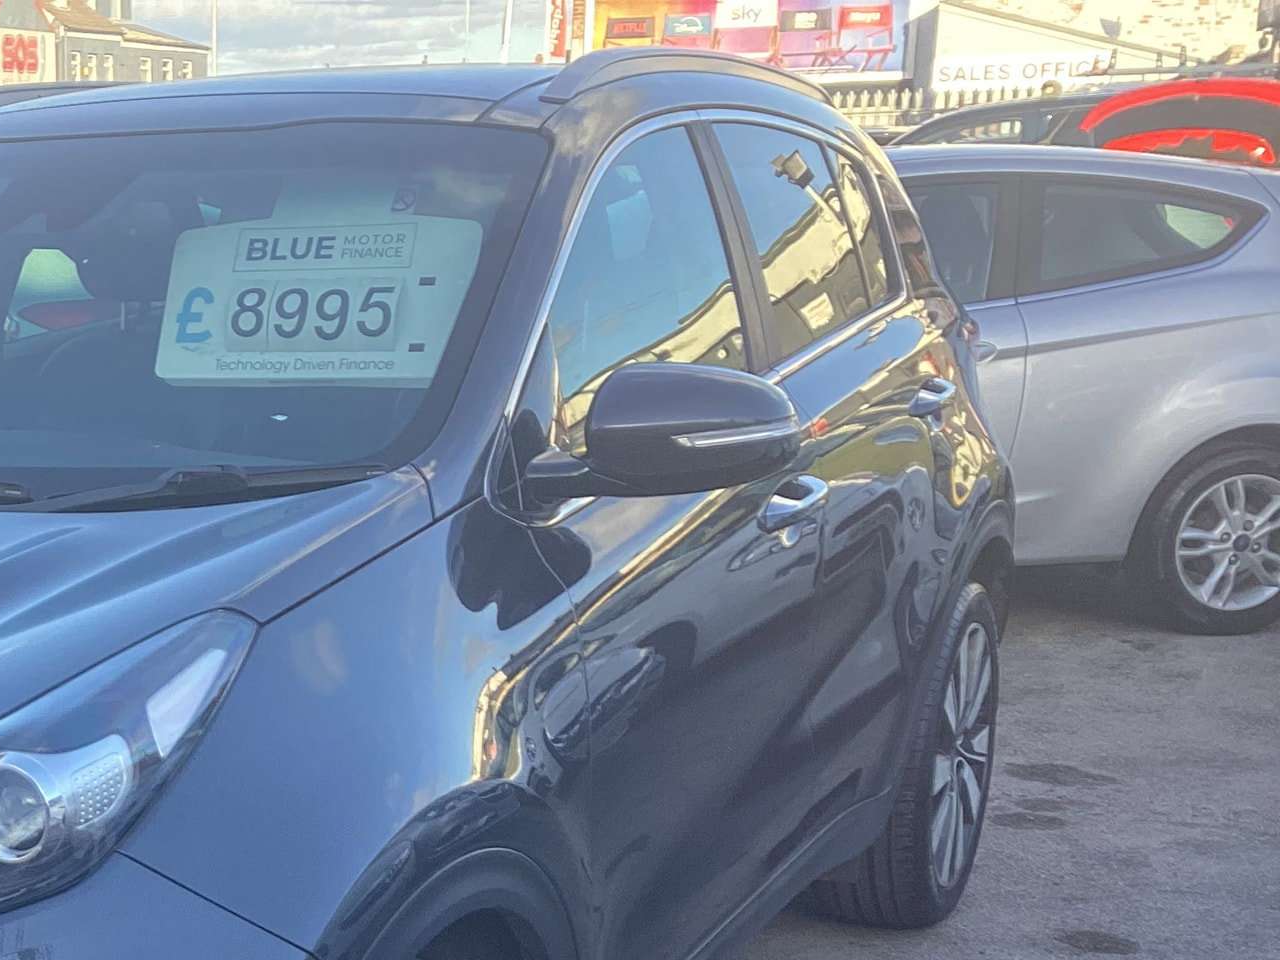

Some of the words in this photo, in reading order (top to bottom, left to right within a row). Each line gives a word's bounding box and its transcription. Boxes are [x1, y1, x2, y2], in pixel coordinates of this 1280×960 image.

[730, 5, 762, 22] sky
[938, 63, 1011, 82] SALES
[245, 235, 337, 261] BLUE
[343, 232, 407, 245] MOTOR
[340, 246, 404, 260] FINANCE
[215, 358, 291, 374] Technology
[293, 358, 339, 371] Driven
[339, 358, 395, 371] Finance
